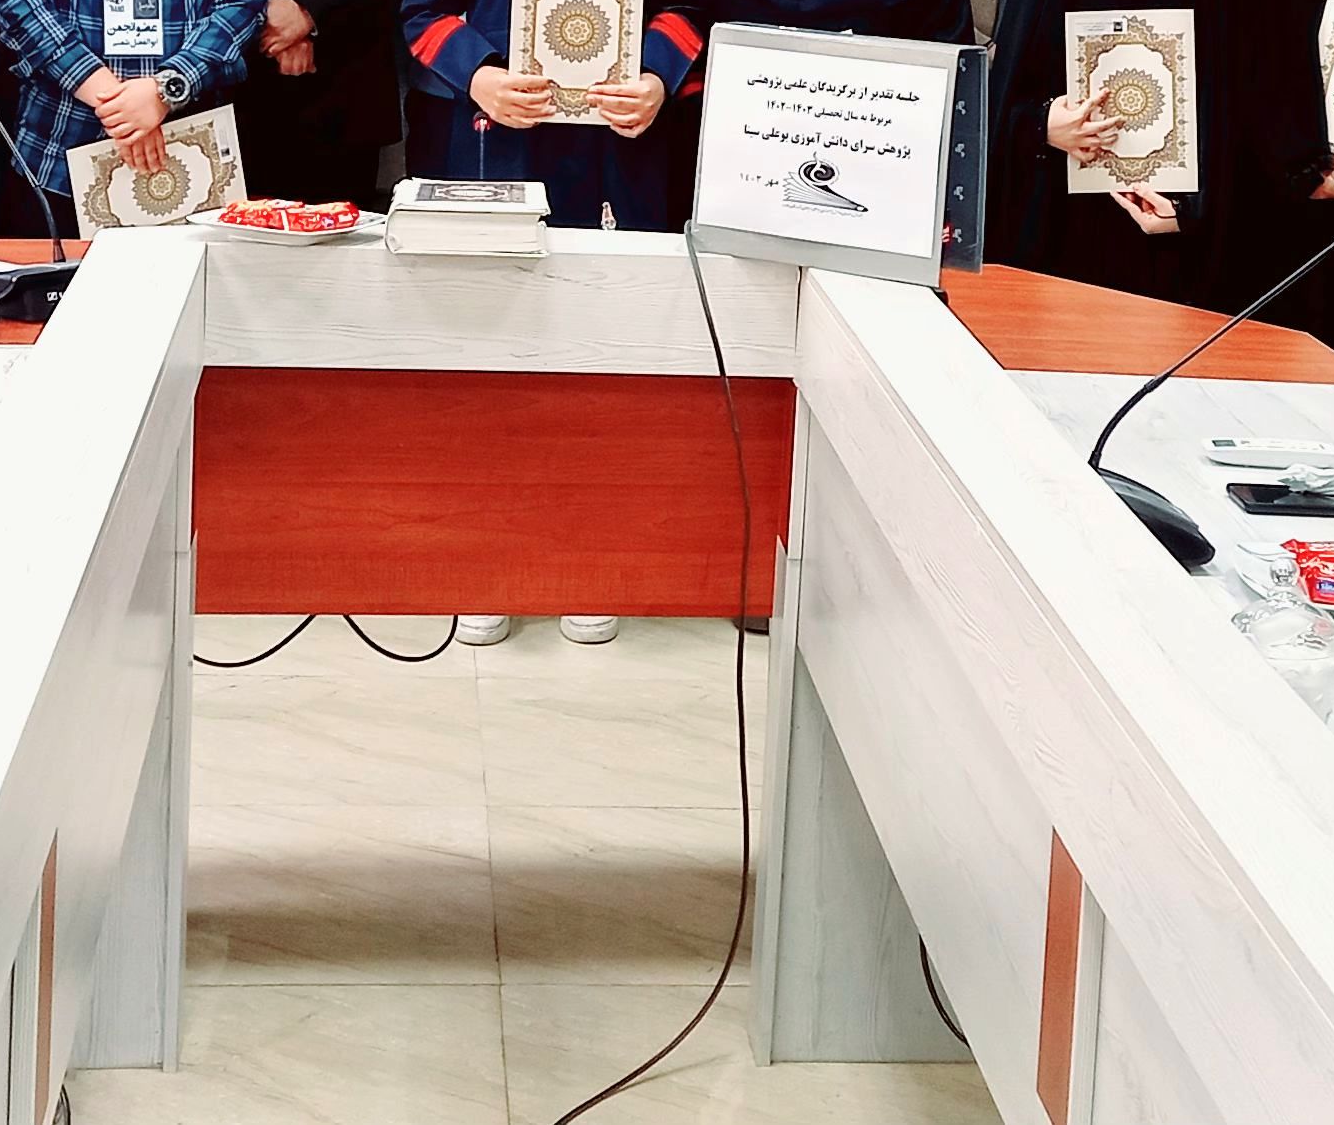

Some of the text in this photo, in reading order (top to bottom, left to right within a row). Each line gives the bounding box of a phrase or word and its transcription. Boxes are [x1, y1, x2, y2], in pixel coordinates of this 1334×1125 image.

[747, 74, 783, 89] پژوهشی
[783, 78, 808, 91] علمی
[858, 86, 868, 100] از
[870, 88, 894, 102] تقدیر
[896, 91, 920, 104] جلسه
[814, 106, 843, 119] تحصیلی
[844, 110, 859, 122] سال
[860, 114, 868, 122] به
[869, 114, 892, 127] مربوط
[743, 123, 912, 160] پژوهش سرای دانش آموزی بوعلی سینا
[764, 178, 779, 188] مهر
